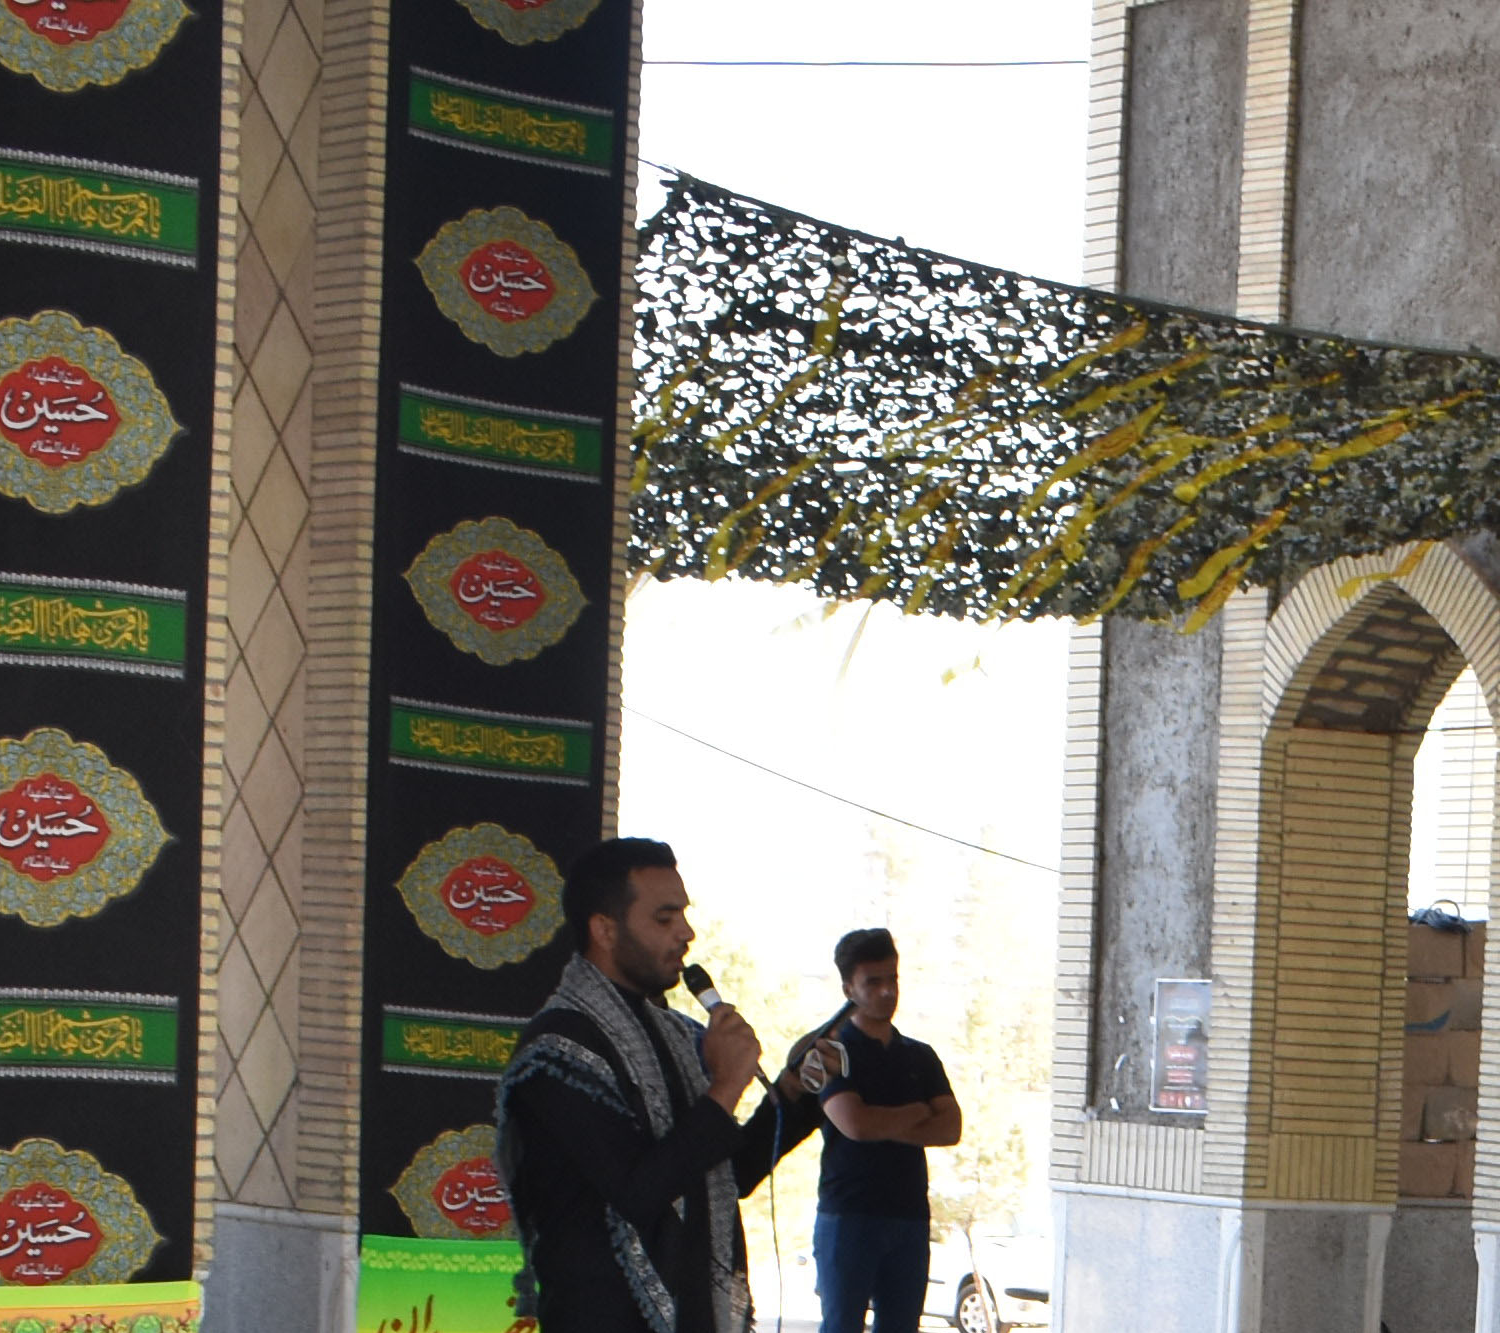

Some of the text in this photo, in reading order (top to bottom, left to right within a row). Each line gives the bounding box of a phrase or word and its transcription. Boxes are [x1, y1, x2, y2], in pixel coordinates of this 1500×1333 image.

[469, 263, 547, 297] حسین
[0, 388, 108, 433] حسین
[459, 574, 537, 606] حسین
[450, 880, 526, 911] حسین
